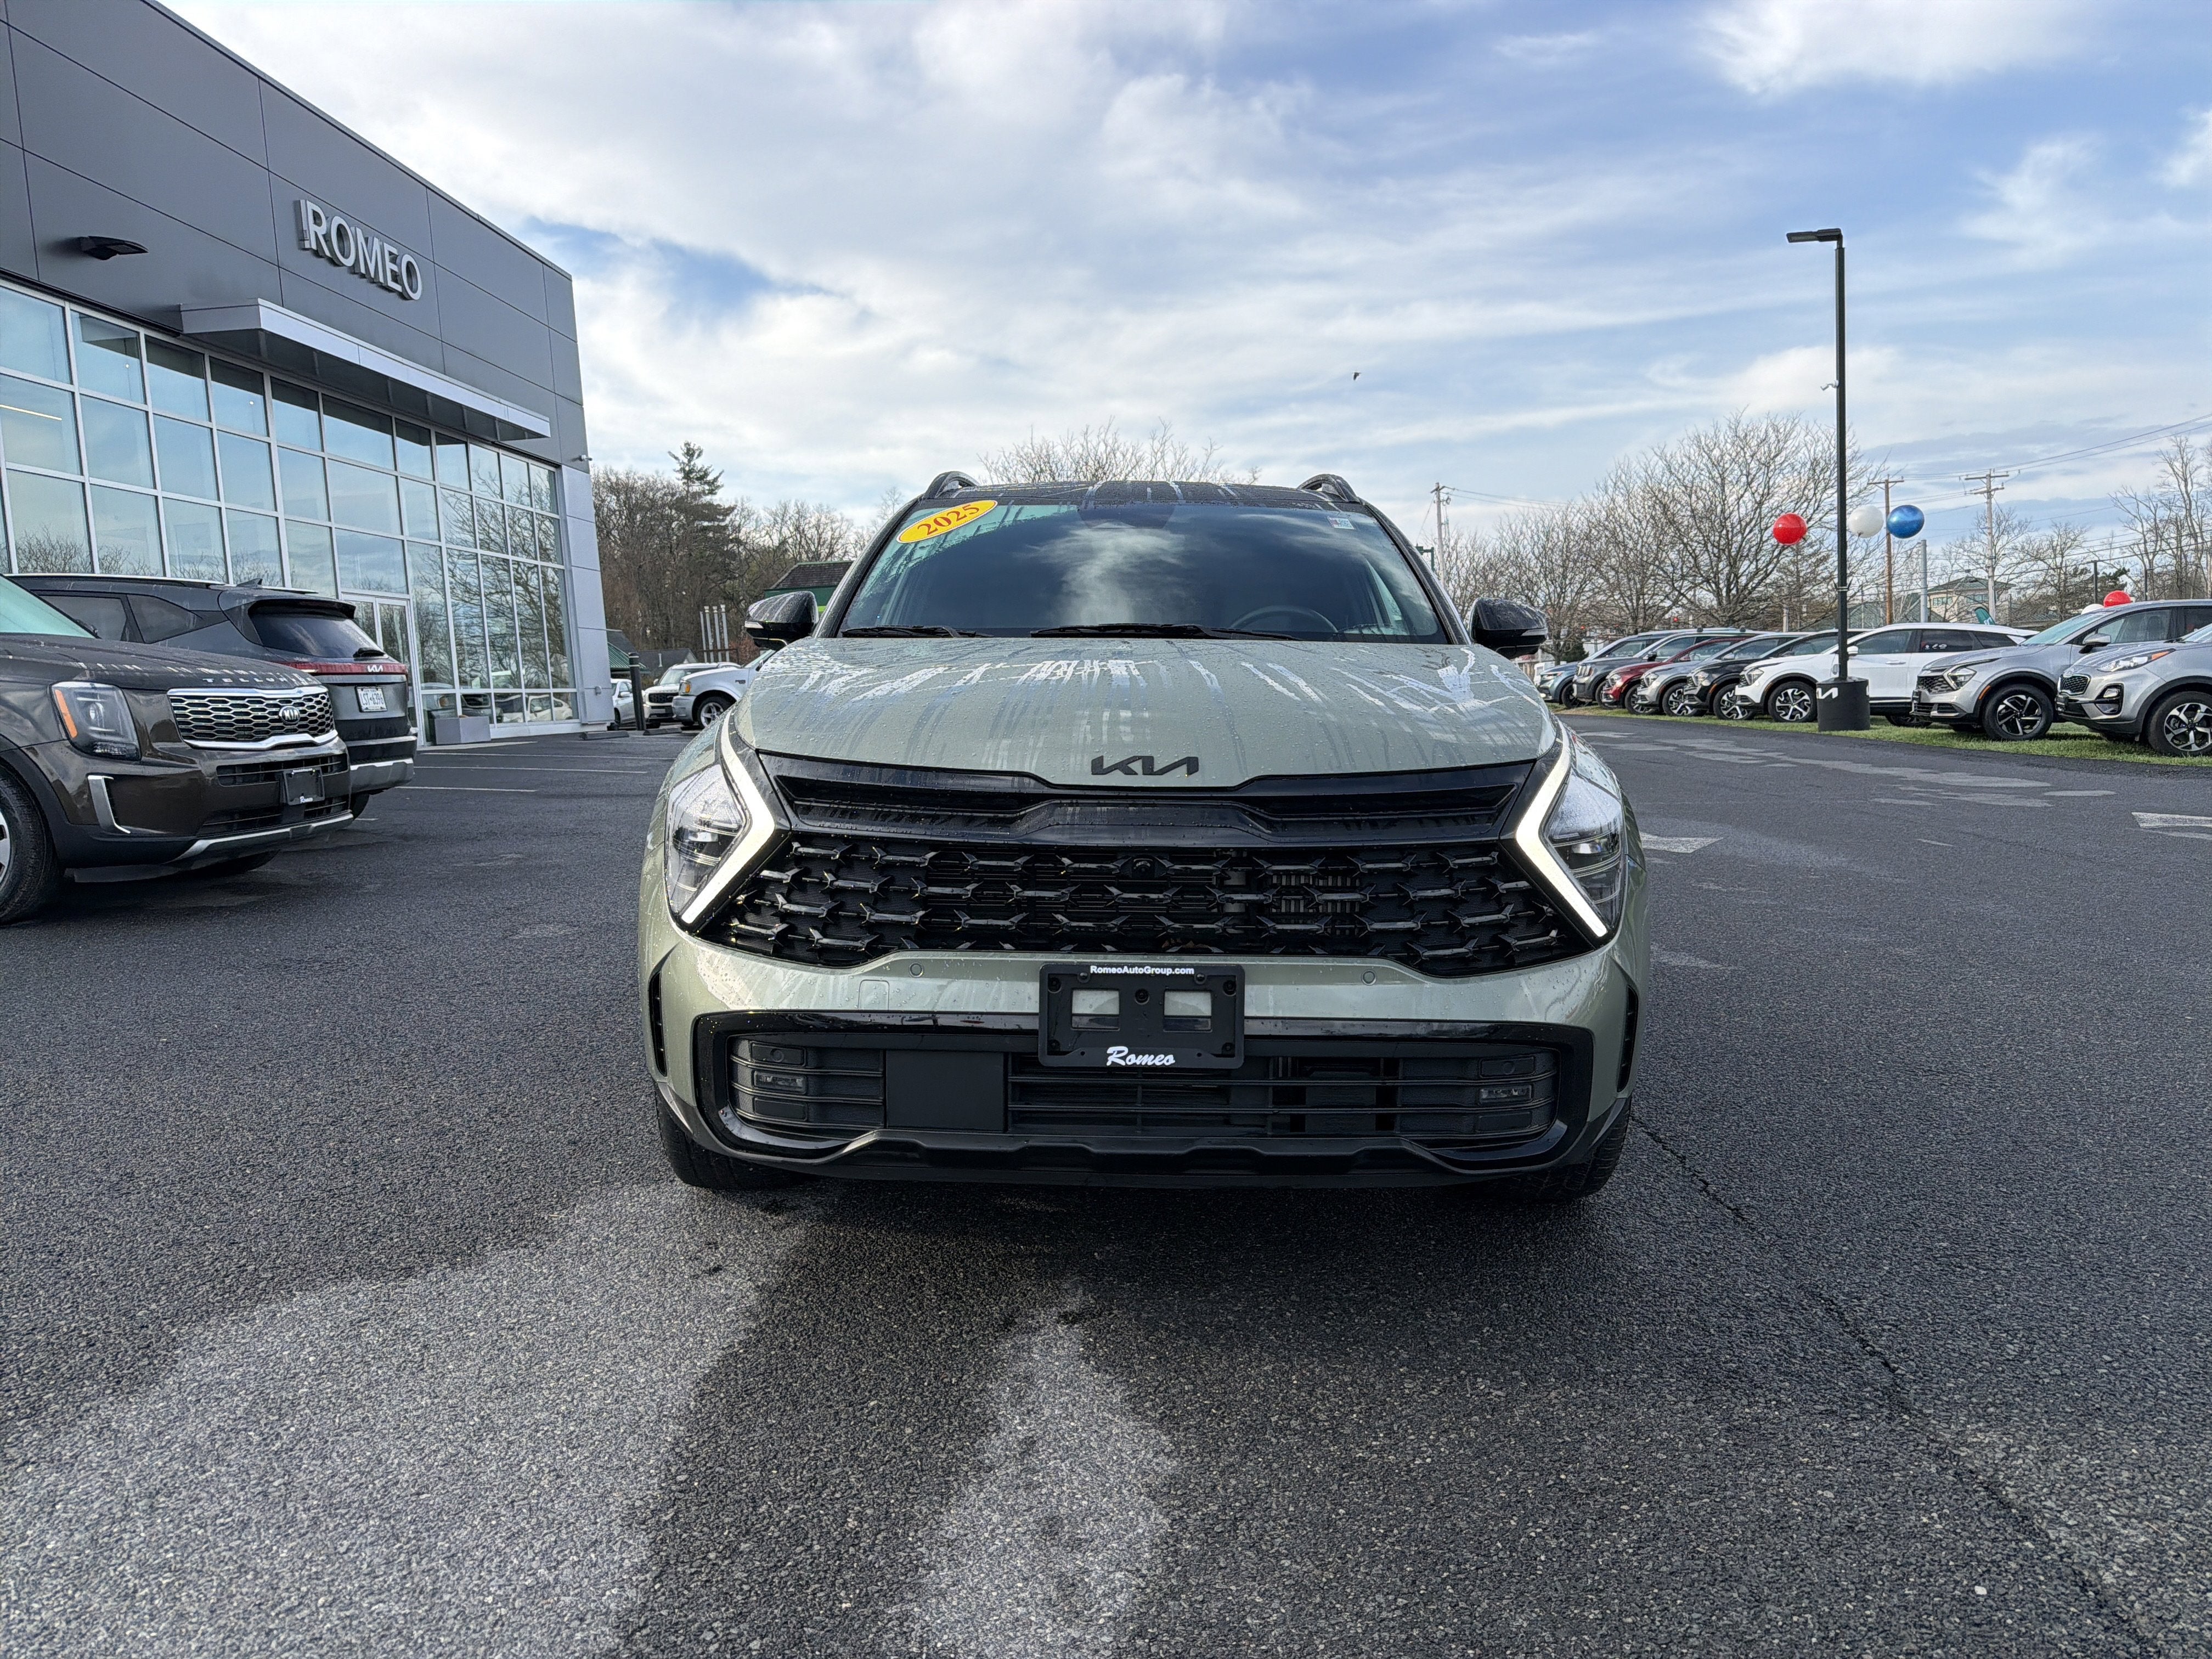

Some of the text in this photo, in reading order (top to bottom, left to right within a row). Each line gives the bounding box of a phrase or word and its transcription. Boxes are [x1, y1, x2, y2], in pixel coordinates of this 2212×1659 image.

[301, 199, 422, 300] ROMEO
[917, 504, 980, 535] 2025
[284, 709, 300, 721] KIA
[1091, 755, 1199, 776] KIA
[1090, 965, 1195, 976] RomeoAutoGroup.com
[1106, 1046, 1176, 1066] Romeo
